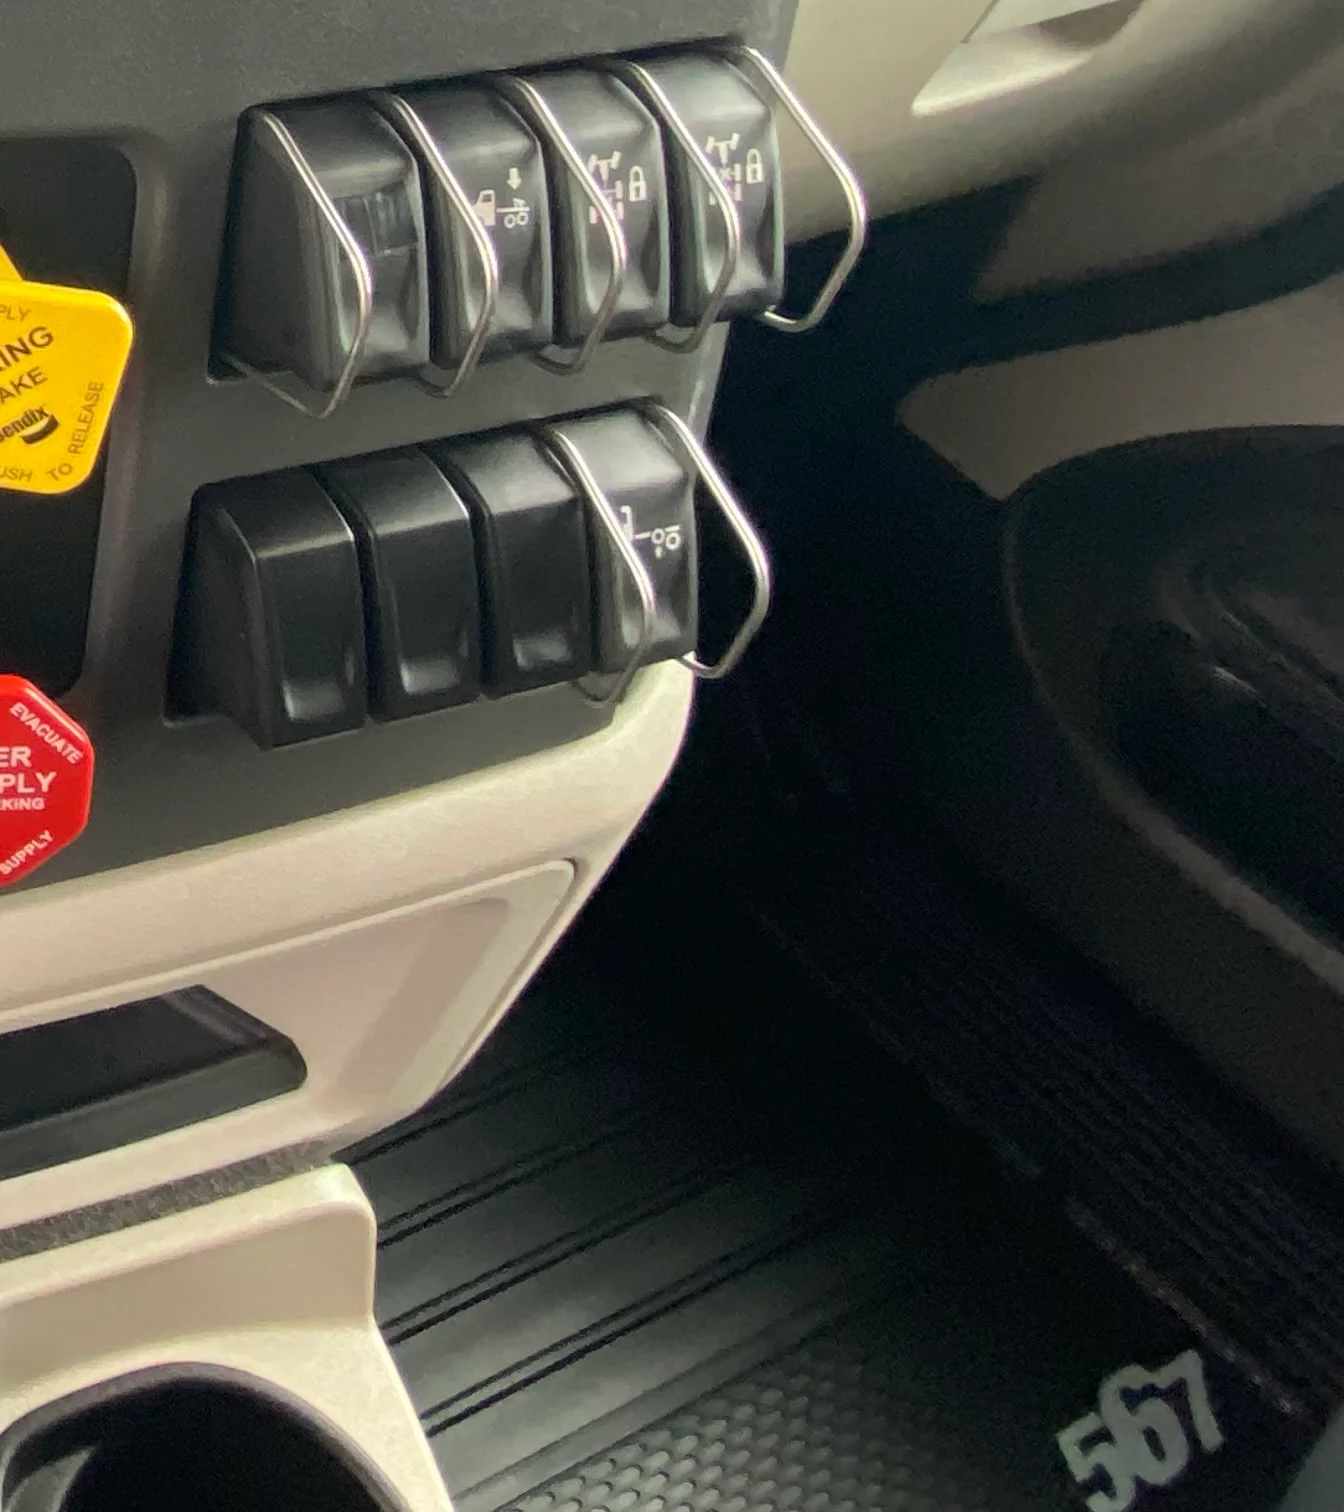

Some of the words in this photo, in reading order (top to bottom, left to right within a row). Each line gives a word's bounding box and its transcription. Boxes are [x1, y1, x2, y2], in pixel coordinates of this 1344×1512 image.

[67, 380, 104, 455] RELEASE
[46, 462, 74, 483] TO
[9, 701, 85, 765] EVACUATE
[1055, 1348, 1225, 1512] 567
